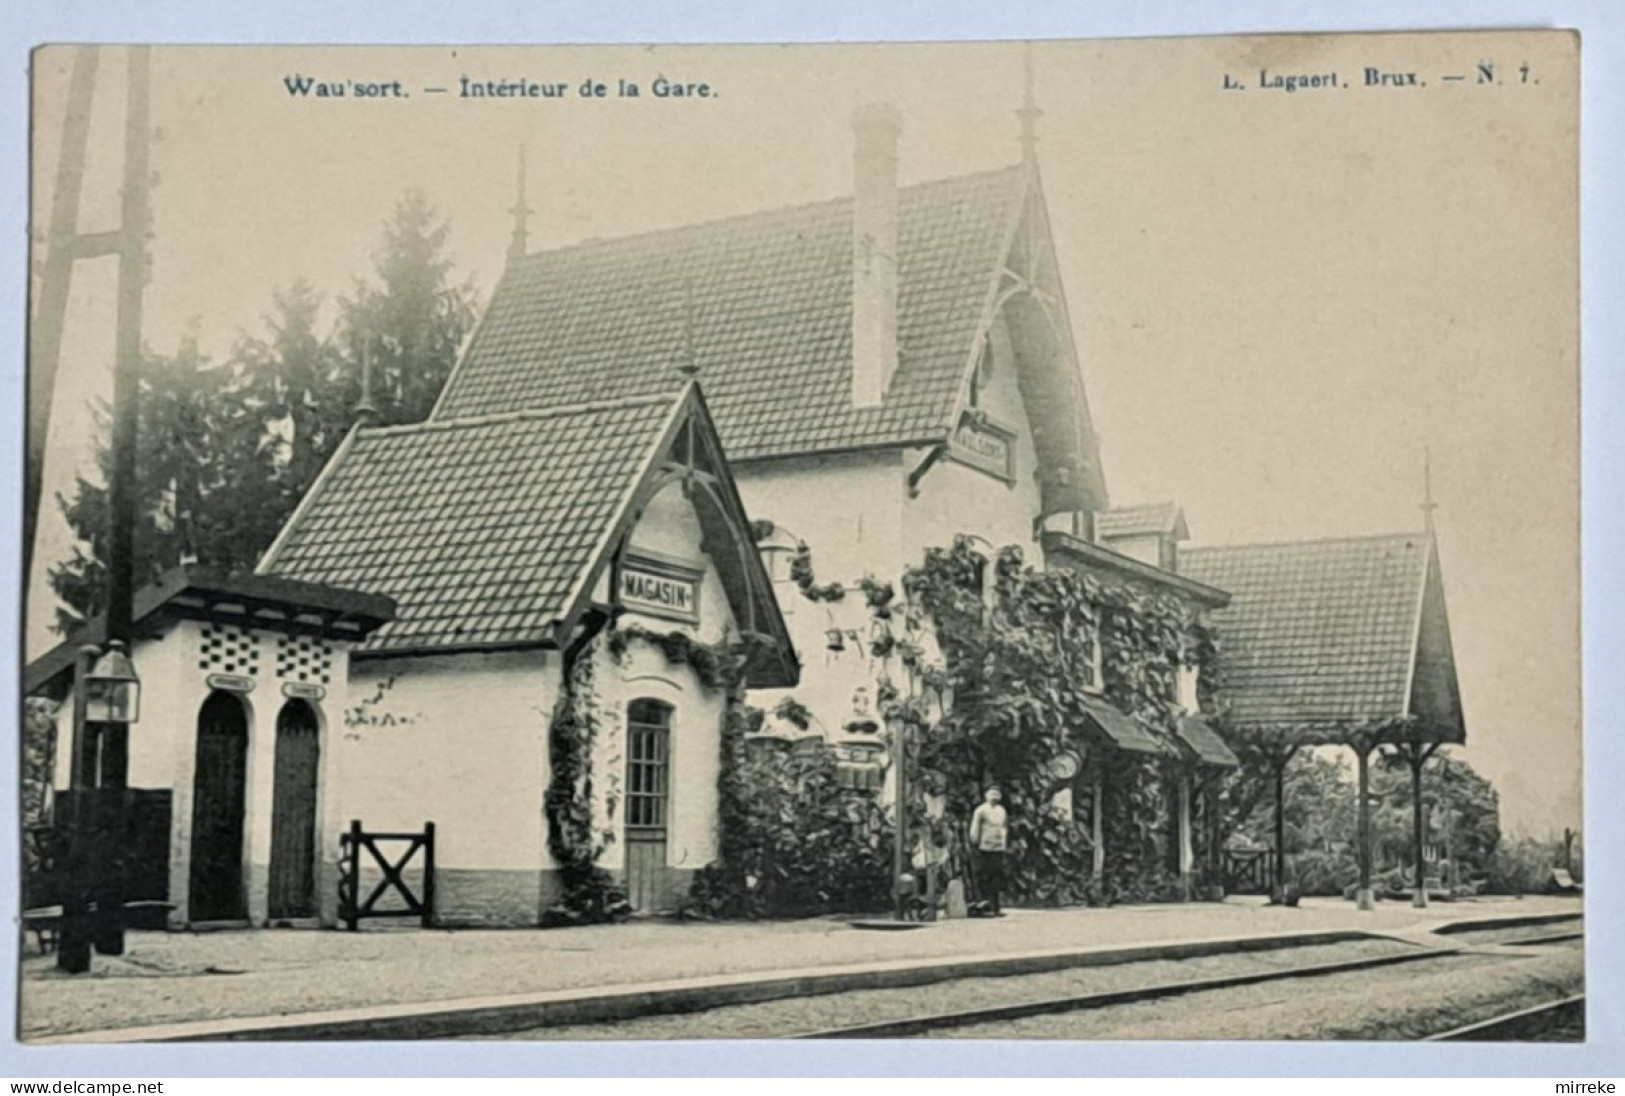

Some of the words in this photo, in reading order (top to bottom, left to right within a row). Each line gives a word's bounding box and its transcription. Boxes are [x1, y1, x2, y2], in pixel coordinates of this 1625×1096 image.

[459, 74, 568, 98] Intérieur
[578, 78, 607, 98] de
[618, 78, 640, 98] la
[652, 74, 719, 98] Gare.
[1364, 67, 1426, 87] Brux.
